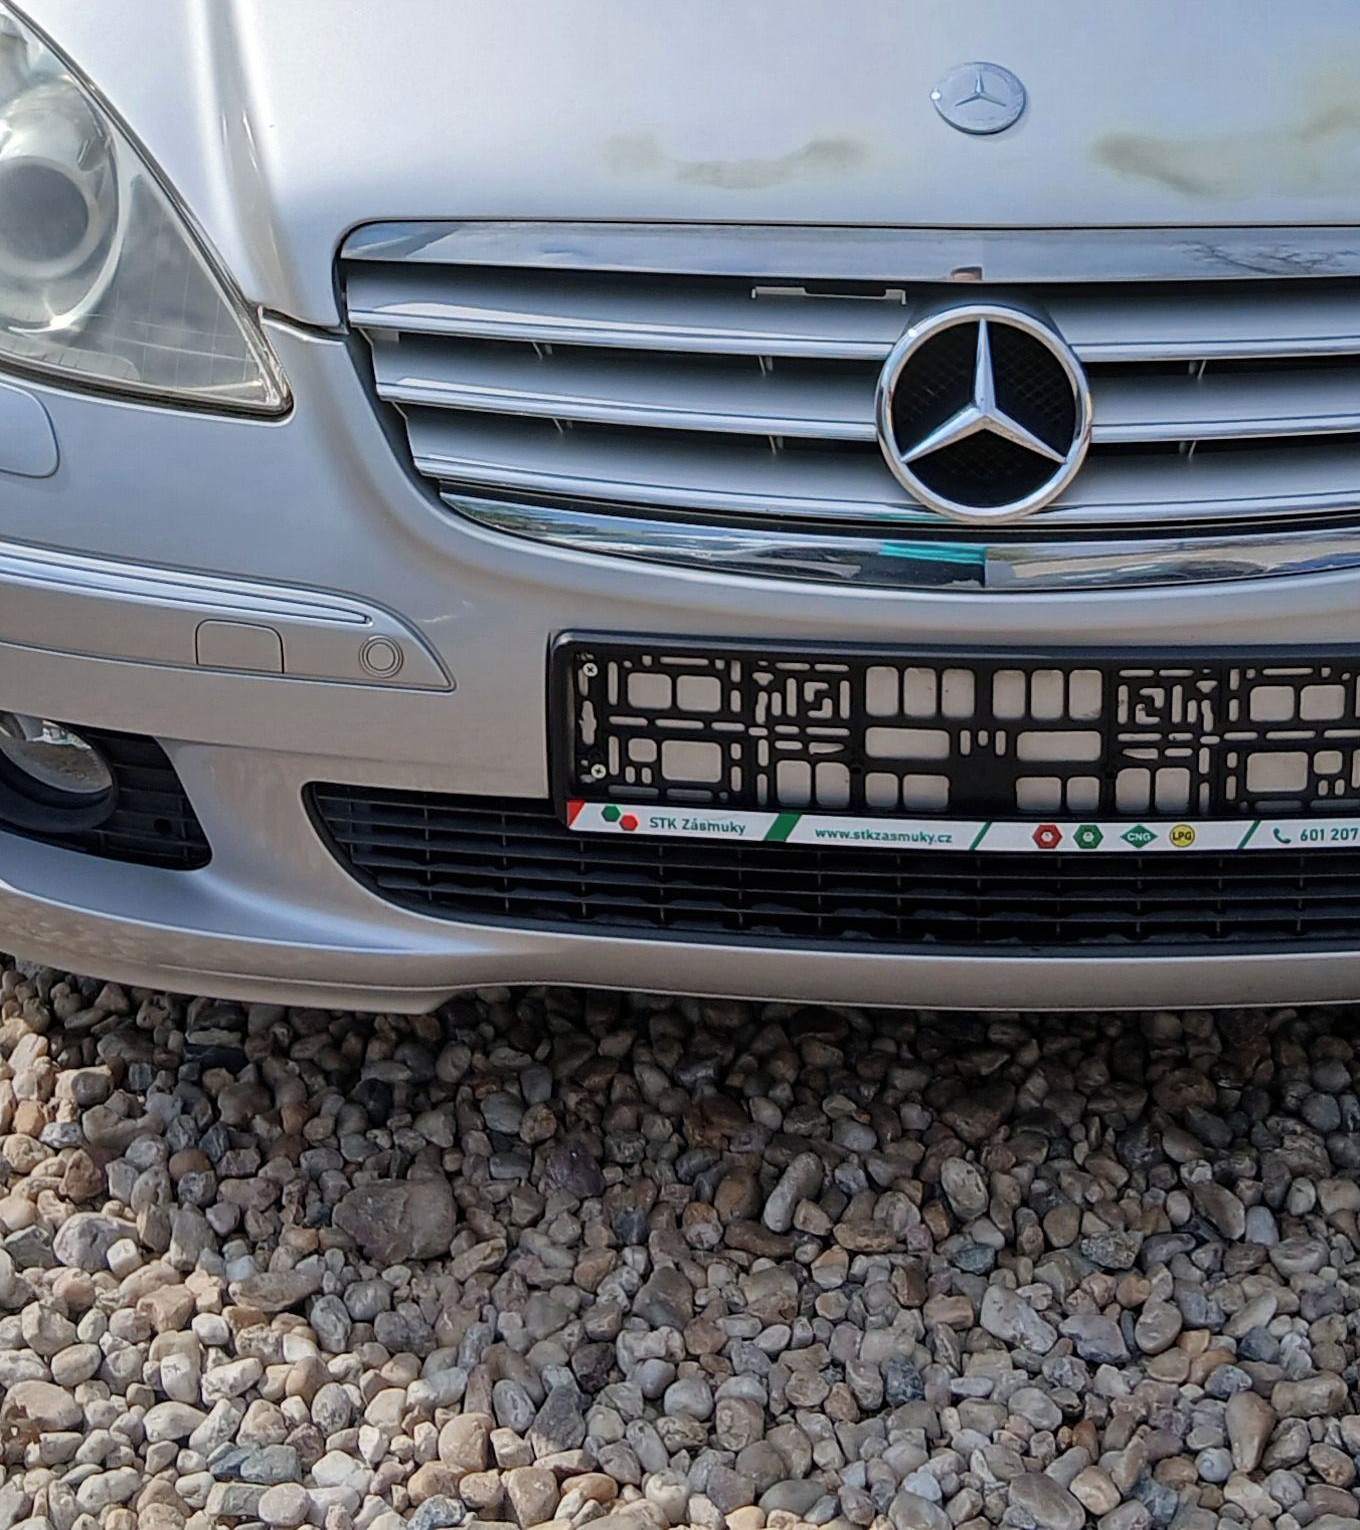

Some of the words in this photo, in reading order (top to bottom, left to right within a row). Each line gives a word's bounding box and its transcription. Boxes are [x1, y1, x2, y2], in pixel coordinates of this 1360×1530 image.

[649, 816, 677, 830] STK
[682, 817, 746, 836] Zásmuky
[814, 828, 953, 845] www.stkzasmuky.cz
[1127, 831, 1152, 843] CNG
[1172, 830, 1192, 842] LPG
[1300, 829, 1326, 842] 601
[1330, 828, 1359, 841] 207
